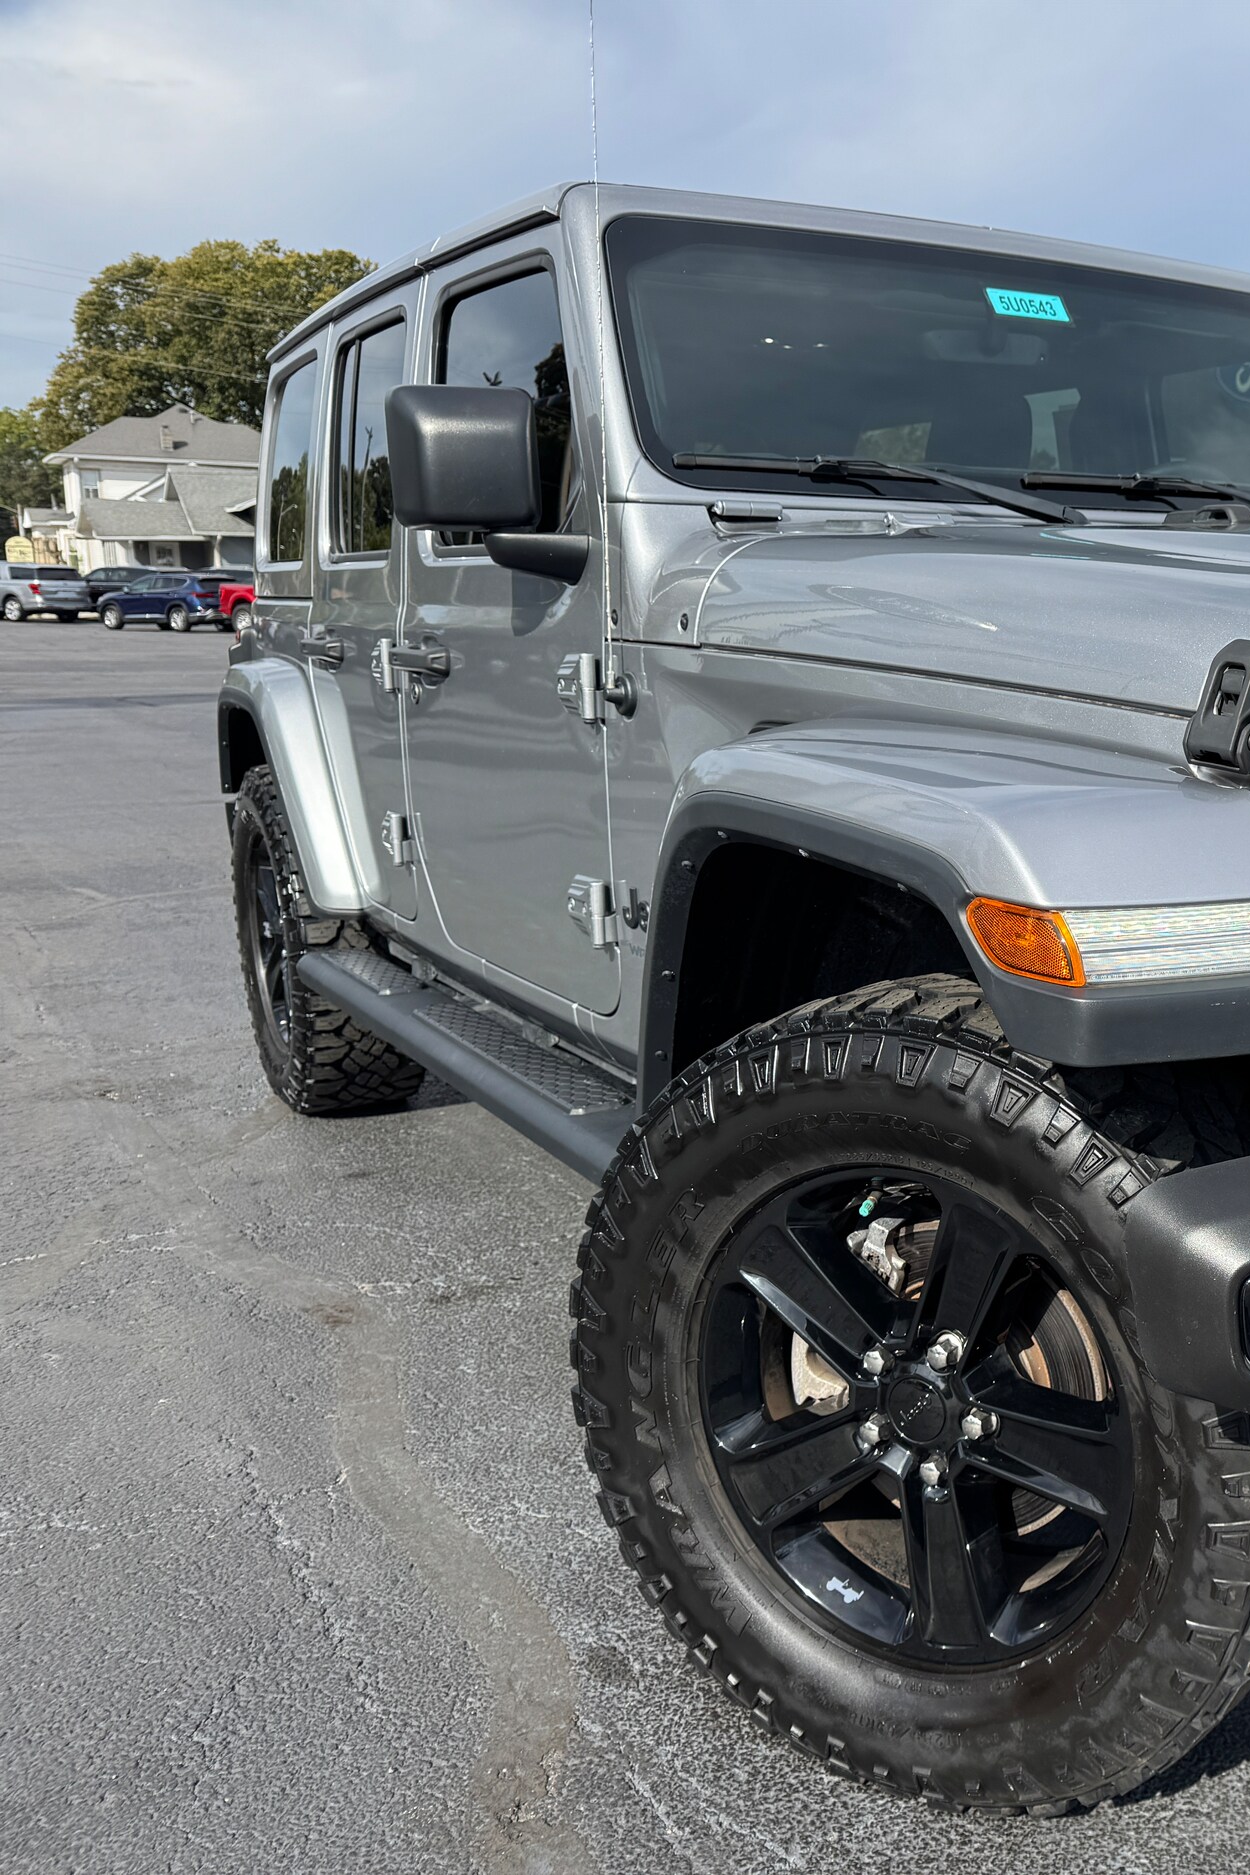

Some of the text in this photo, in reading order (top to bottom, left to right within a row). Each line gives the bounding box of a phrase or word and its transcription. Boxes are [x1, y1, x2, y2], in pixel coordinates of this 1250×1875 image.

[998, 295, 1057, 317] 5U0543
[738, 1110, 973, 1155] DURATRAC
[626, 1187, 753, 1638] WRANGLER
